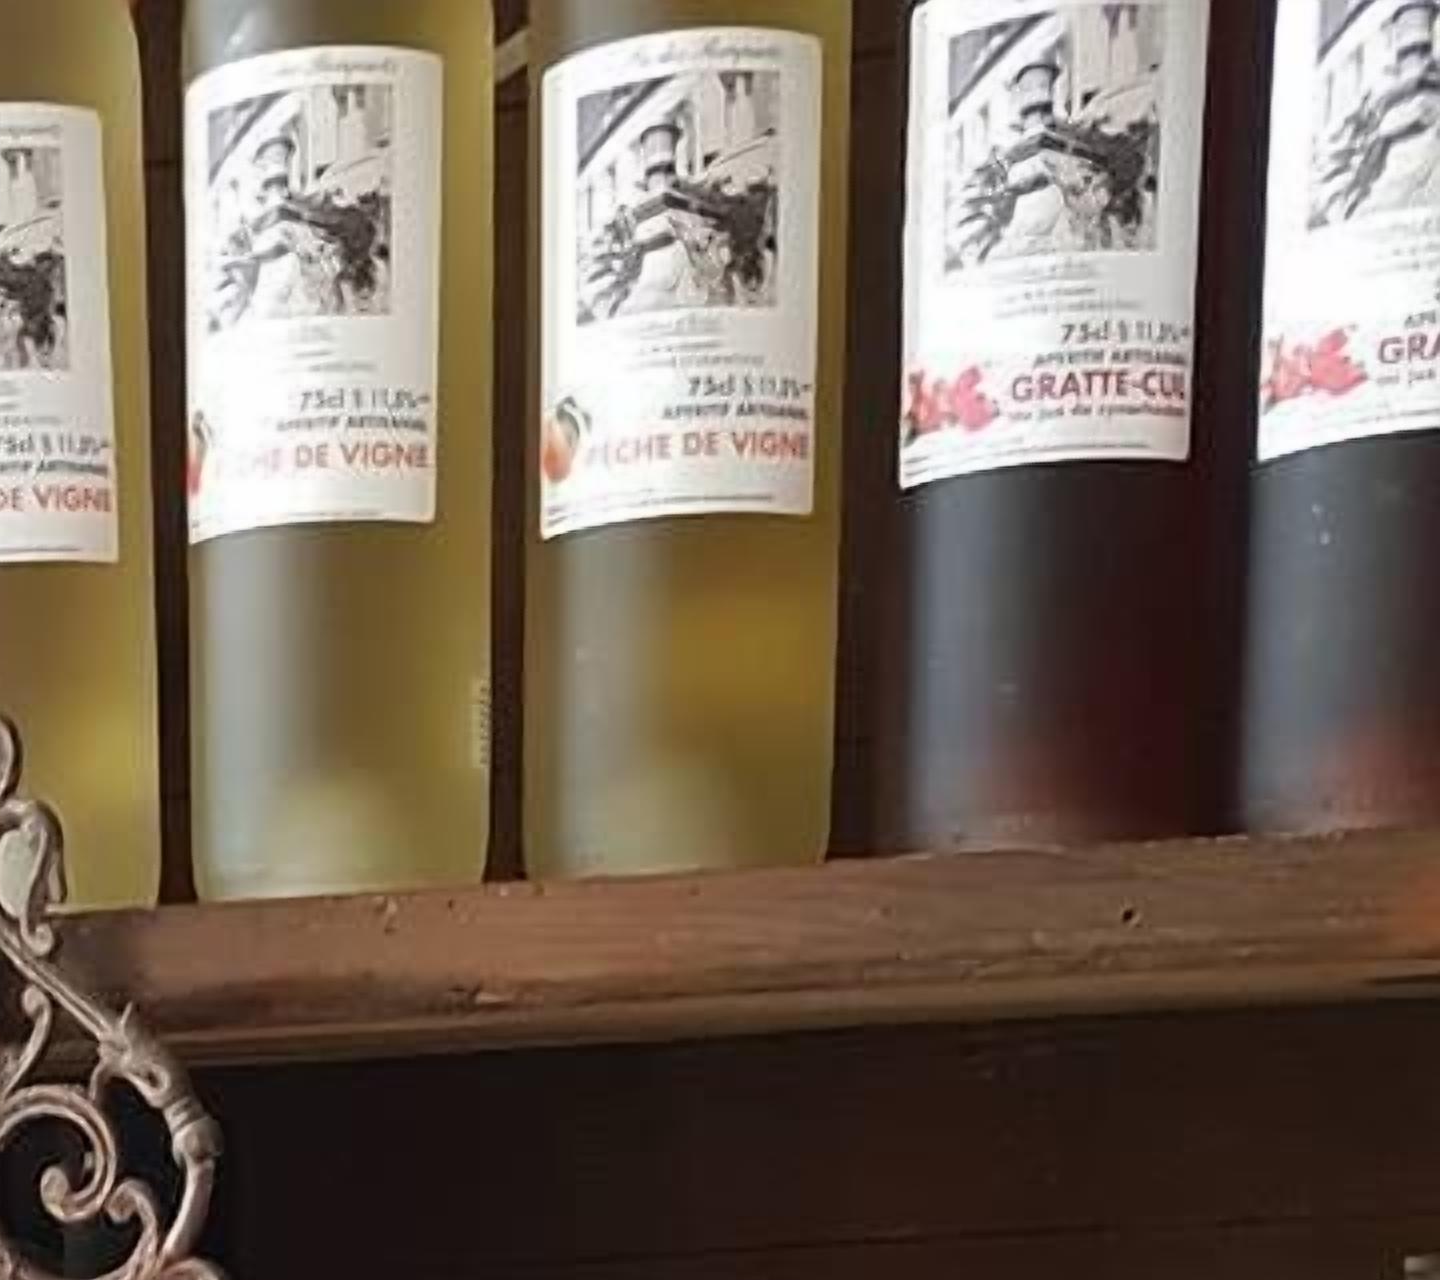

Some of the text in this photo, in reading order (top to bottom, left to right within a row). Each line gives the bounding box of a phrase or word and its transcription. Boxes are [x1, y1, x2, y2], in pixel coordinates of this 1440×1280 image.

[1011, 368, 1186, 401] GRATTE-CUL
[295, 443, 329, 469] DE
[339, 441, 429, 471] VIGNE
[682, 431, 721, 457] DE
[731, 430, 809, 461] VIGNE
[32, 486, 112, 513] VIGNE
